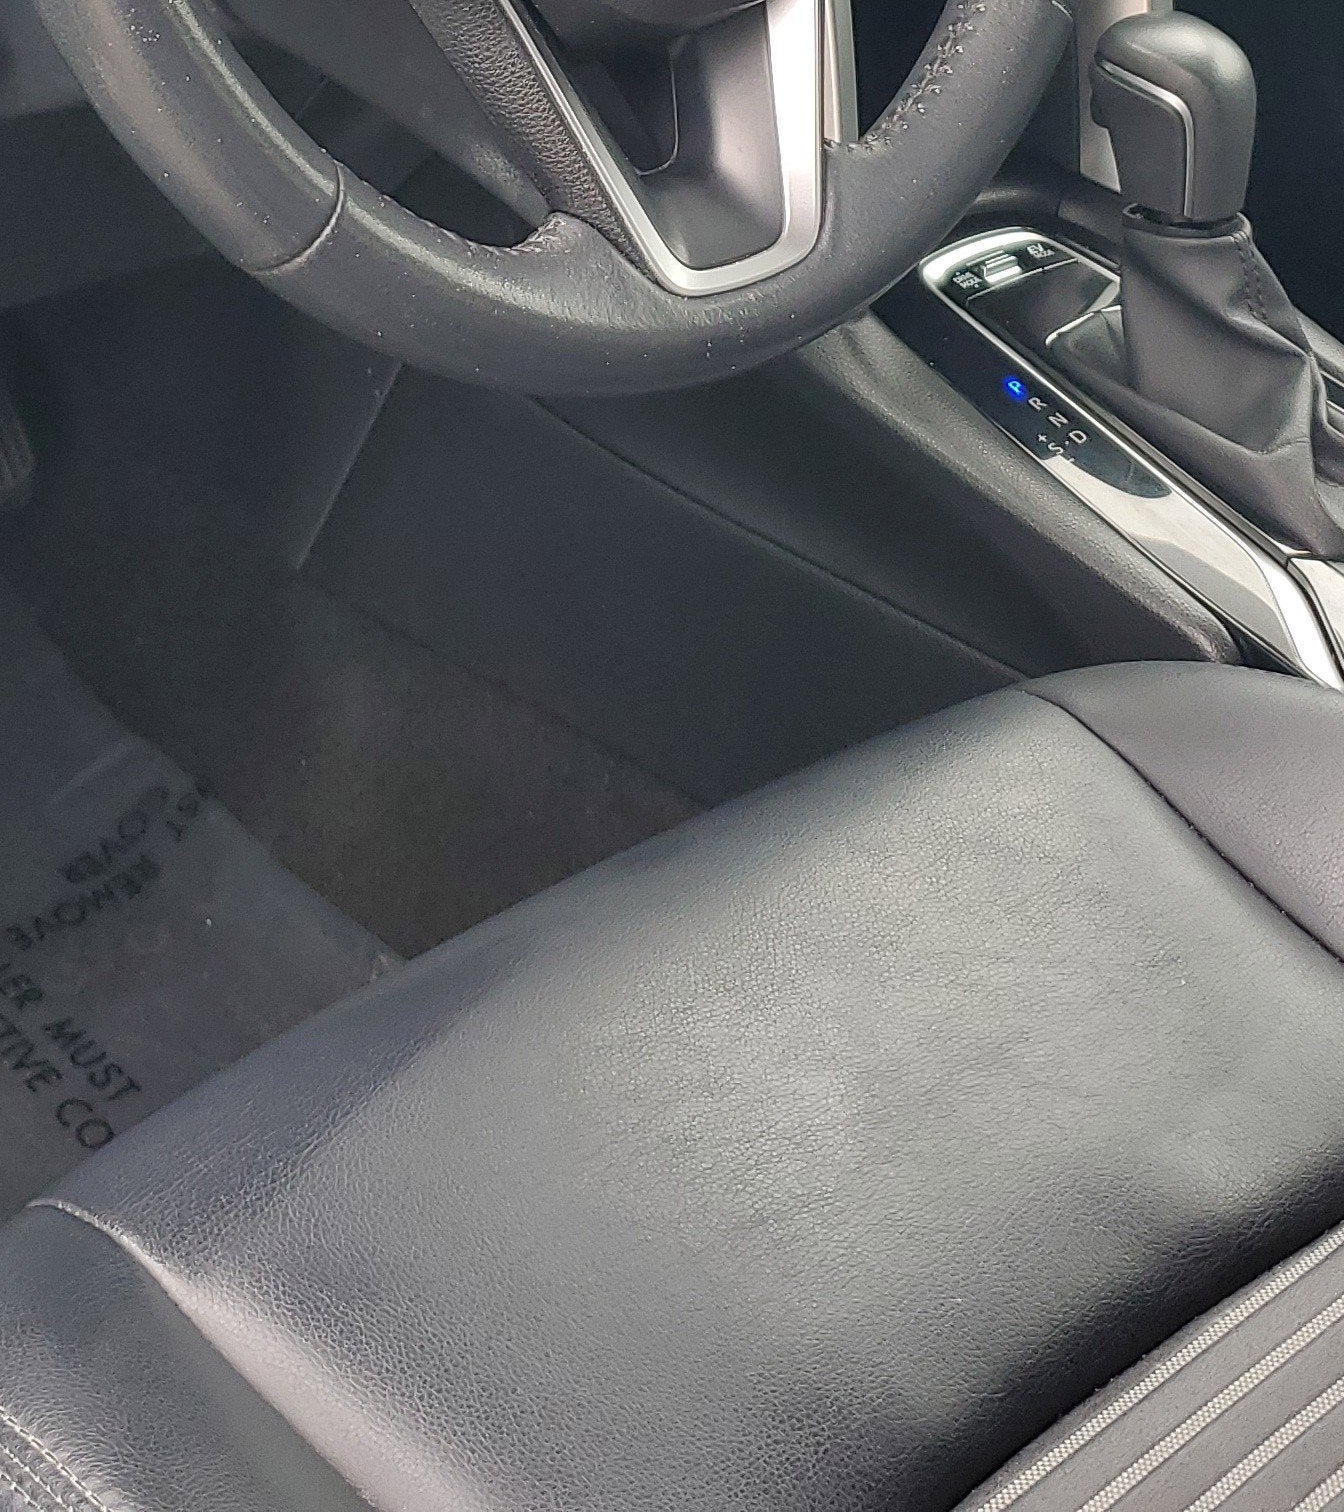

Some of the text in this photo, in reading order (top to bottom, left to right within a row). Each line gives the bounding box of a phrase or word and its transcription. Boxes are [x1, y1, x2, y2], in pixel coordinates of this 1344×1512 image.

[1008, 380, 1023, 396] P
[1027, 397, 1048, 412] R
[1048, 411, 1069, 428] N
[1068, 430, 1088, 444] D
[42, 1015, 144, 1104] MUST
